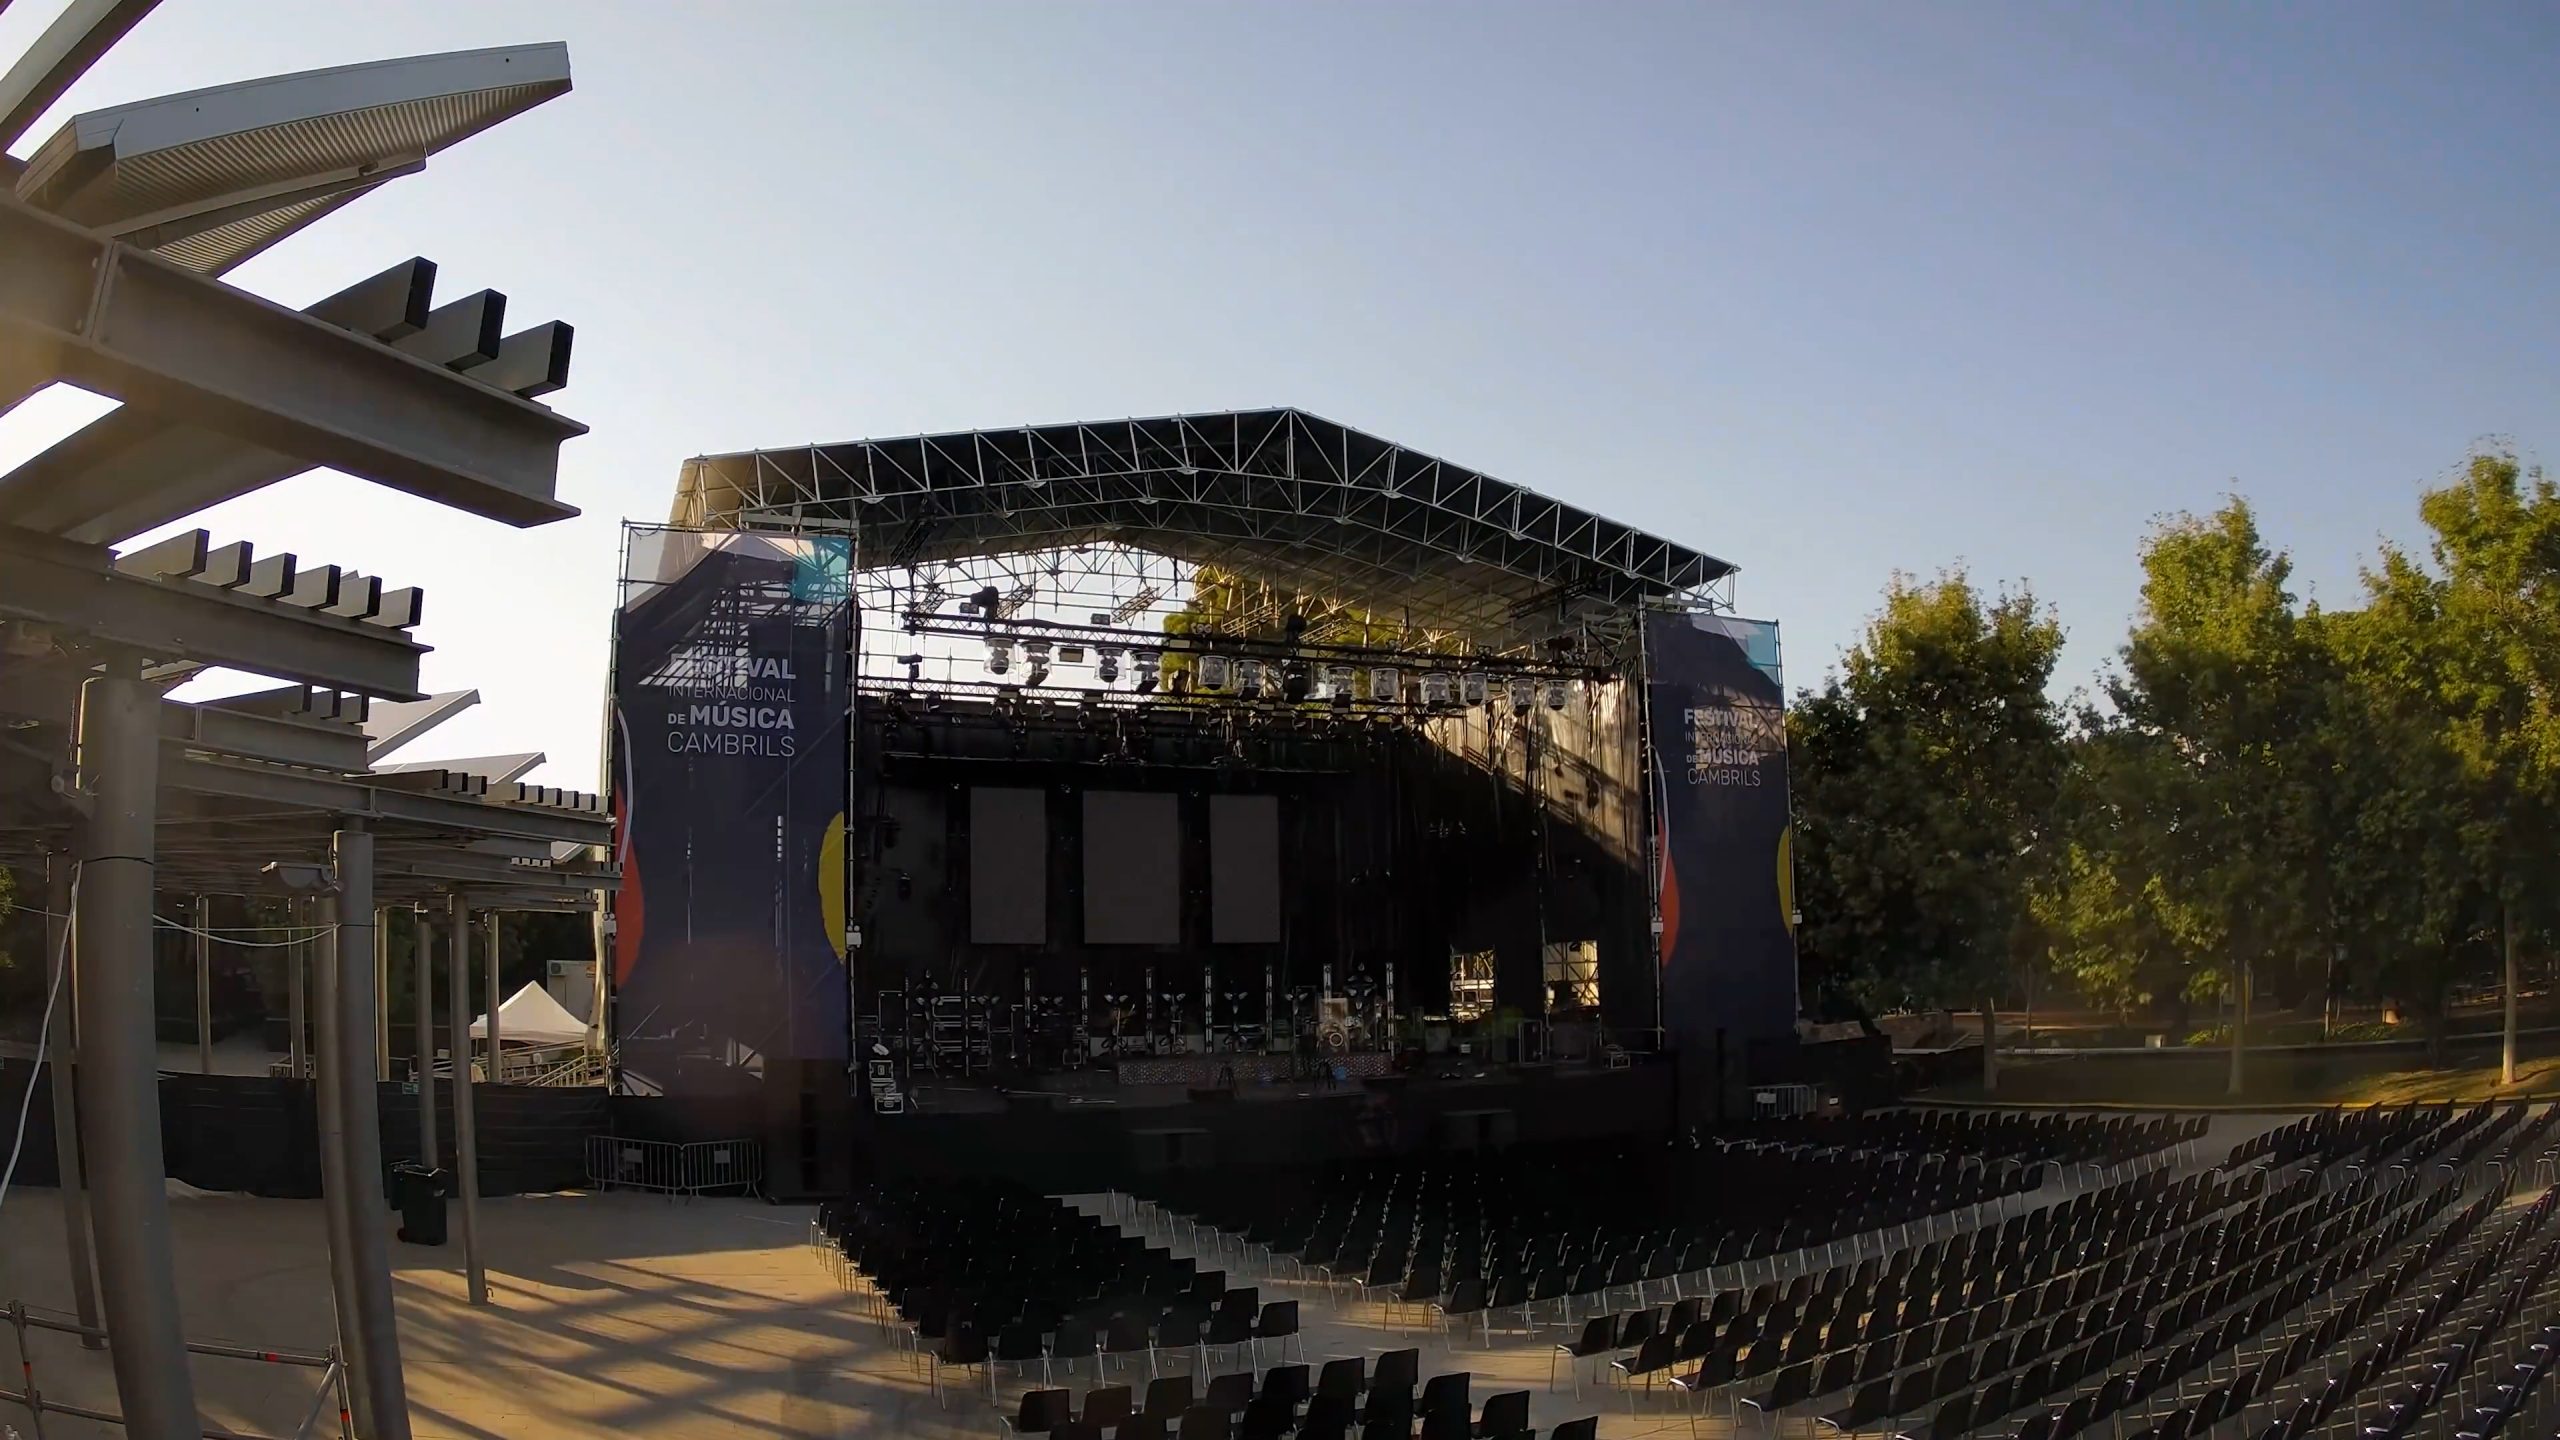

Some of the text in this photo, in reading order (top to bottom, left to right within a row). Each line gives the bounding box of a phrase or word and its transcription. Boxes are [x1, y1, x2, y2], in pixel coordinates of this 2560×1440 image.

[668, 684, 796, 703] INTERNACIONAL
[667, 700, 795, 730] DE MÚSICA
[667, 731, 795, 757] CAMBRILS
[1687, 768, 1761, 787] CAMBRILS
